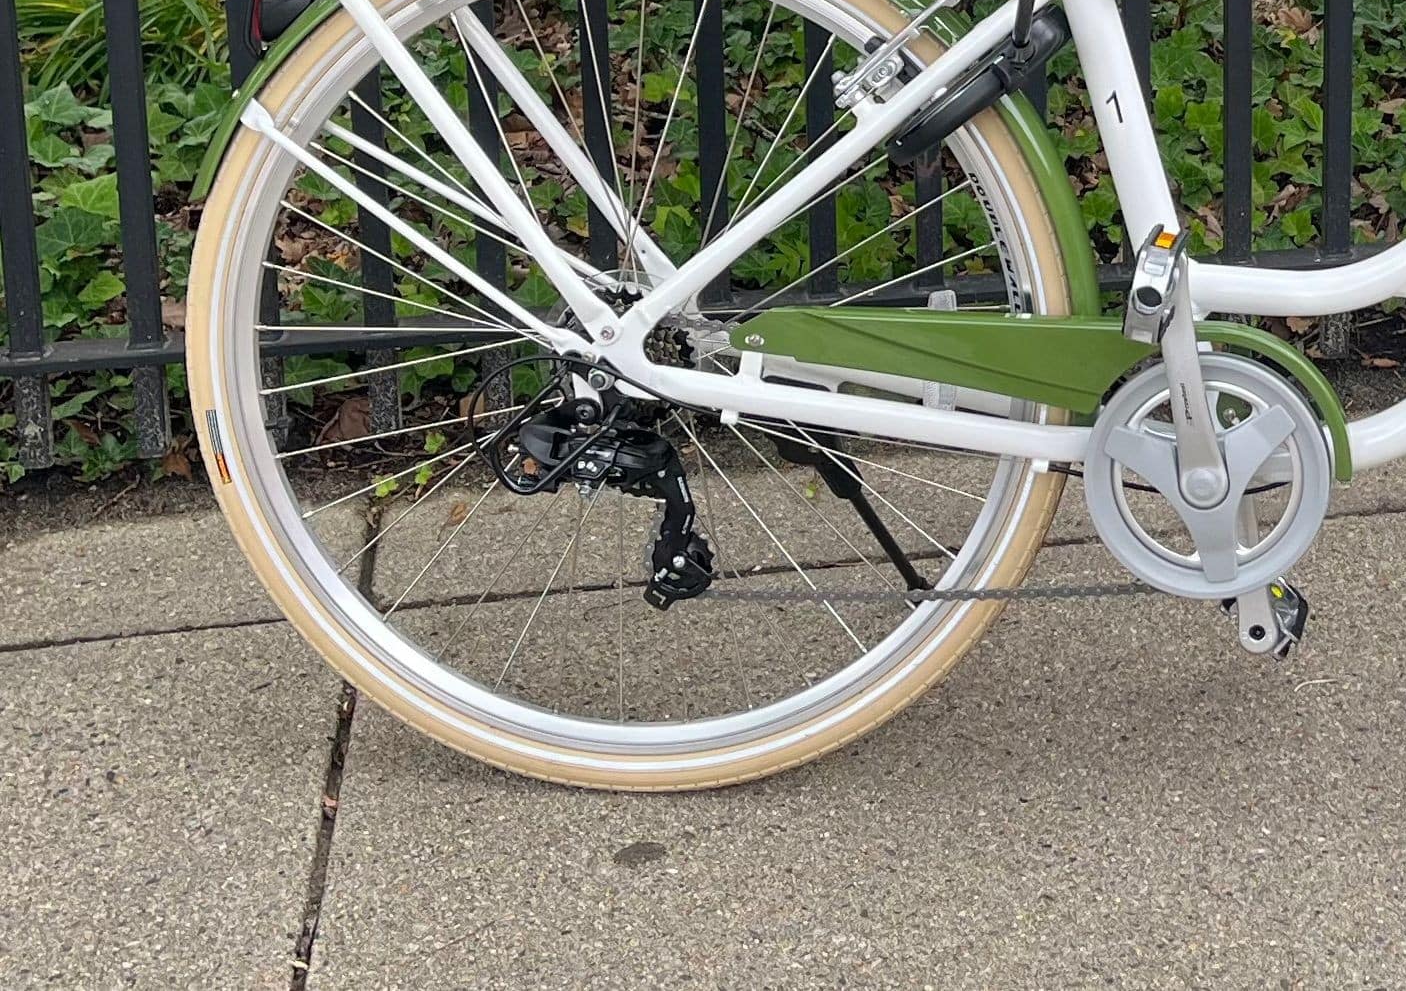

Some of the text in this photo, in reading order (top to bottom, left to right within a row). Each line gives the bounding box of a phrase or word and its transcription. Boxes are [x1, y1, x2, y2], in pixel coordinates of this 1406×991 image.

[1105, 90, 1124, 123] 1
[968, 172, 1021, 311] DOUBLE WALL
